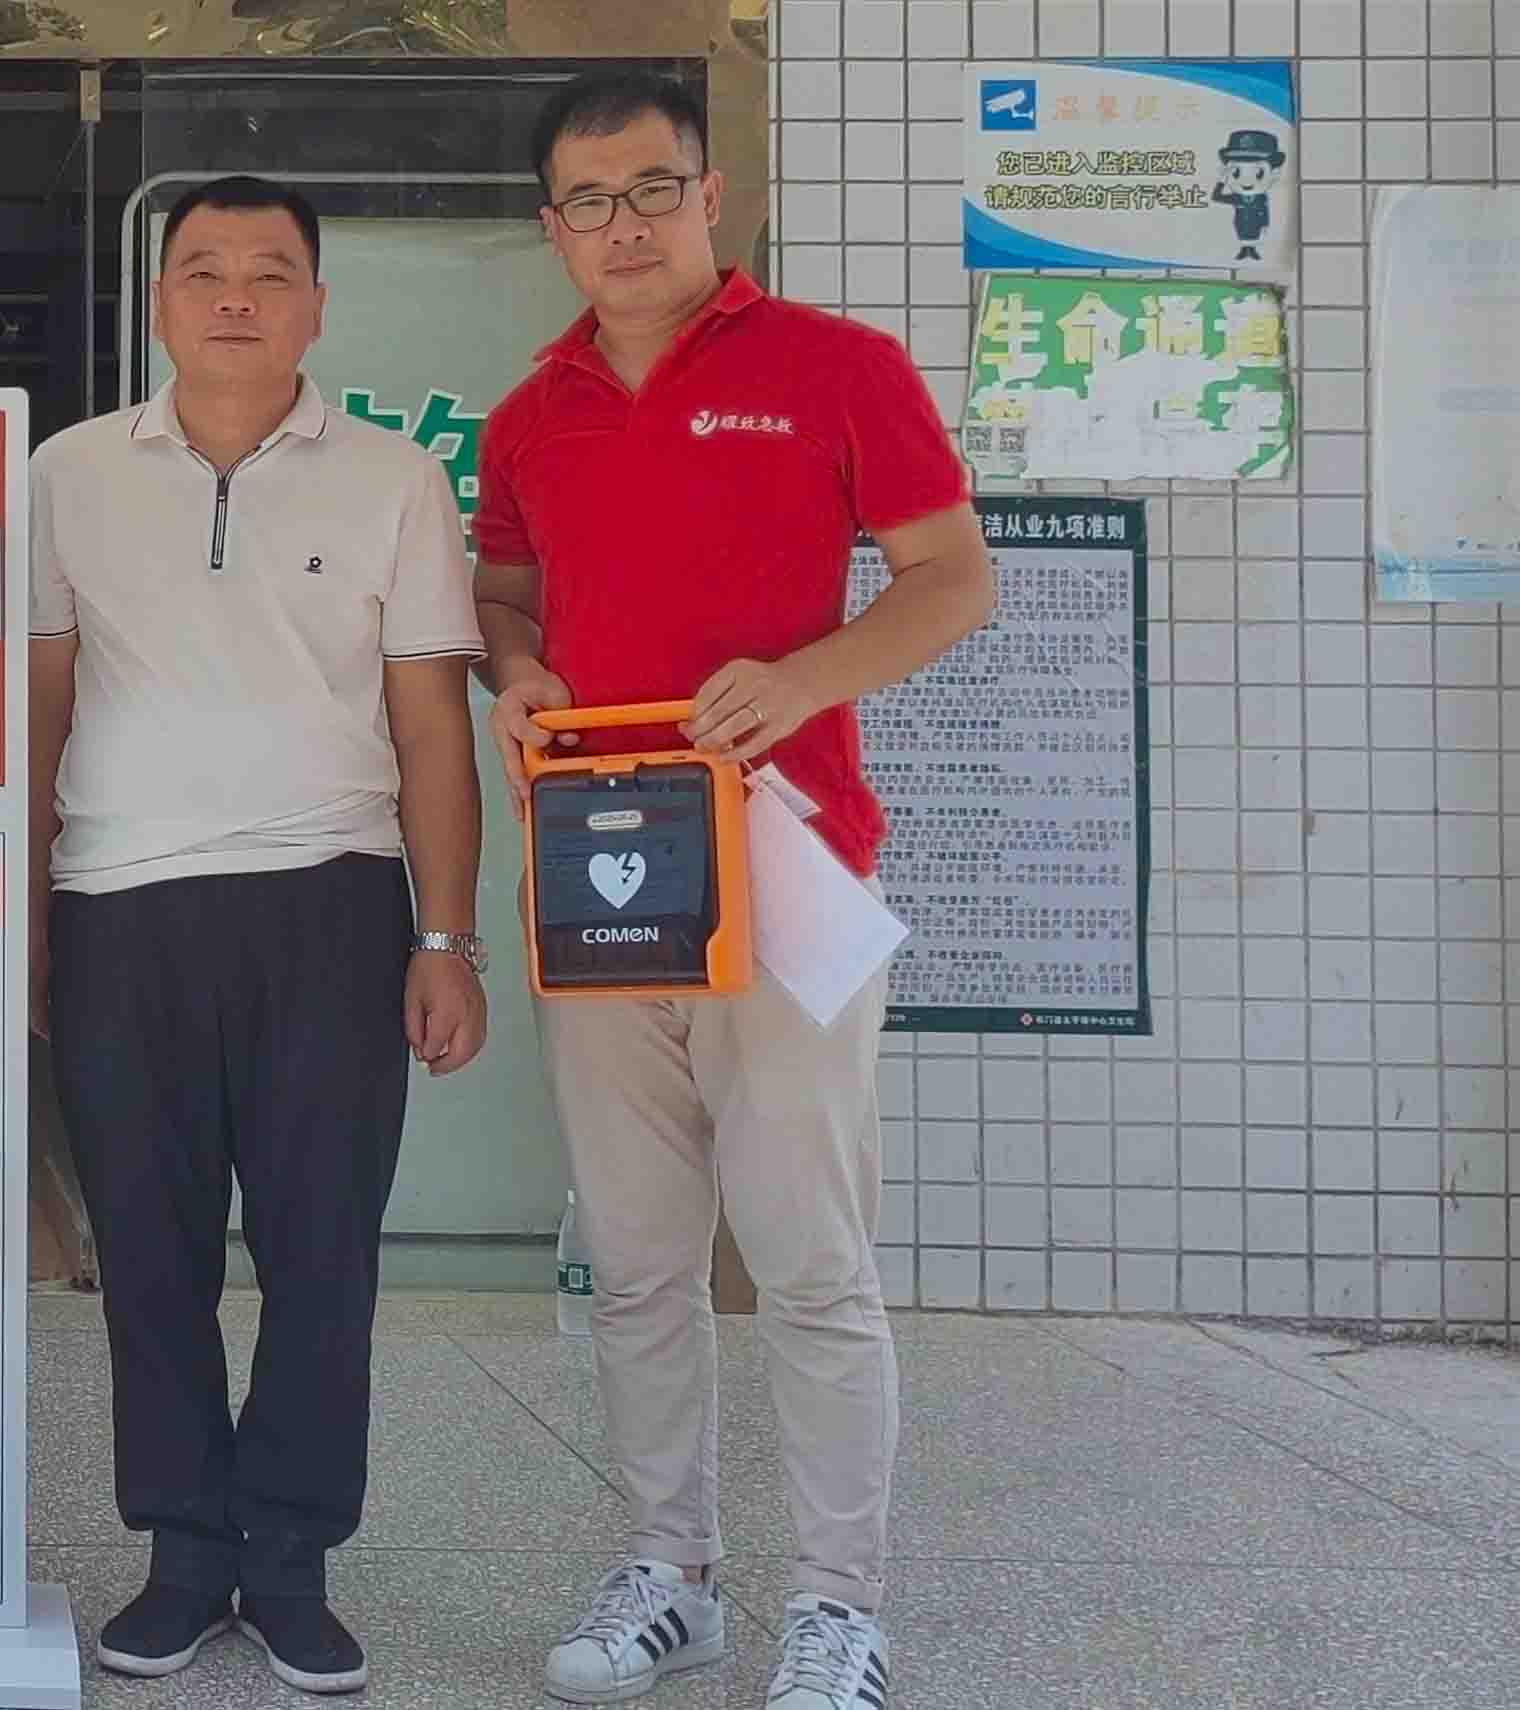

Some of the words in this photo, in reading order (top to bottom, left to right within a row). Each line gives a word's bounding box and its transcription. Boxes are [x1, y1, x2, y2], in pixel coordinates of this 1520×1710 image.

[996, 150, 1196, 177] 您已进入监控区域
[984, 184, 1209, 210] 请规范您的言行举止
[980, 291, 1283, 374] 生命通道
[976, 513, 1126, 541] 洁从业九项准则
